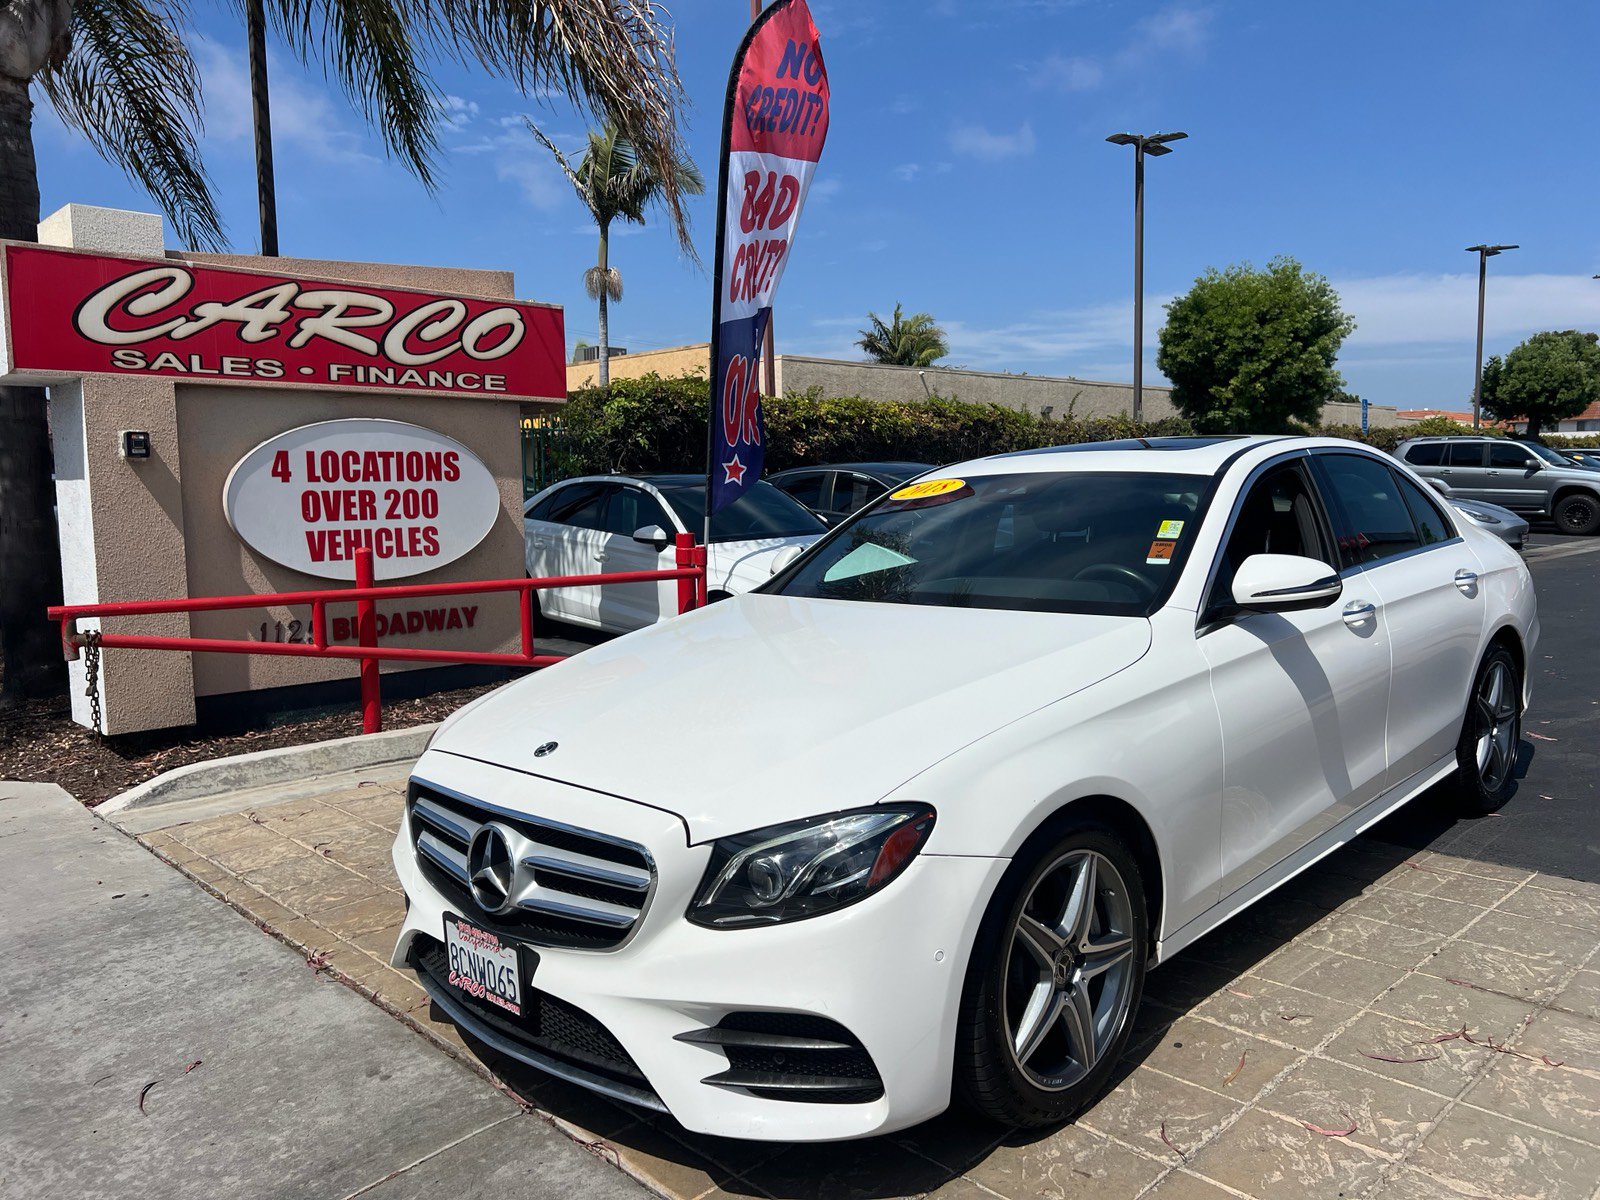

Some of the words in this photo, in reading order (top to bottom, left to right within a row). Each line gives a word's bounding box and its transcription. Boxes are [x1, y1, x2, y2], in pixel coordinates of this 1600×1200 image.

[776, 38, 822, 86] NO
[745, 84, 824, 136] CREDIT?
[739, 170, 800, 234] BAD
[76, 266, 526, 366] CARCO
[111, 349, 285, 379] SALES
[329, 363, 508, 392] FINANCE
[722, 353, 761, 447] OK
[271, 450, 292, 483] 4
[305, 450, 461, 483] LOCATIONS
[301, 489, 377, 523] OVER
[384, 488, 439, 520] 200
[305, 525, 441, 563] VEHICLES
[449, 942, 517, 1002] 8CNW065
